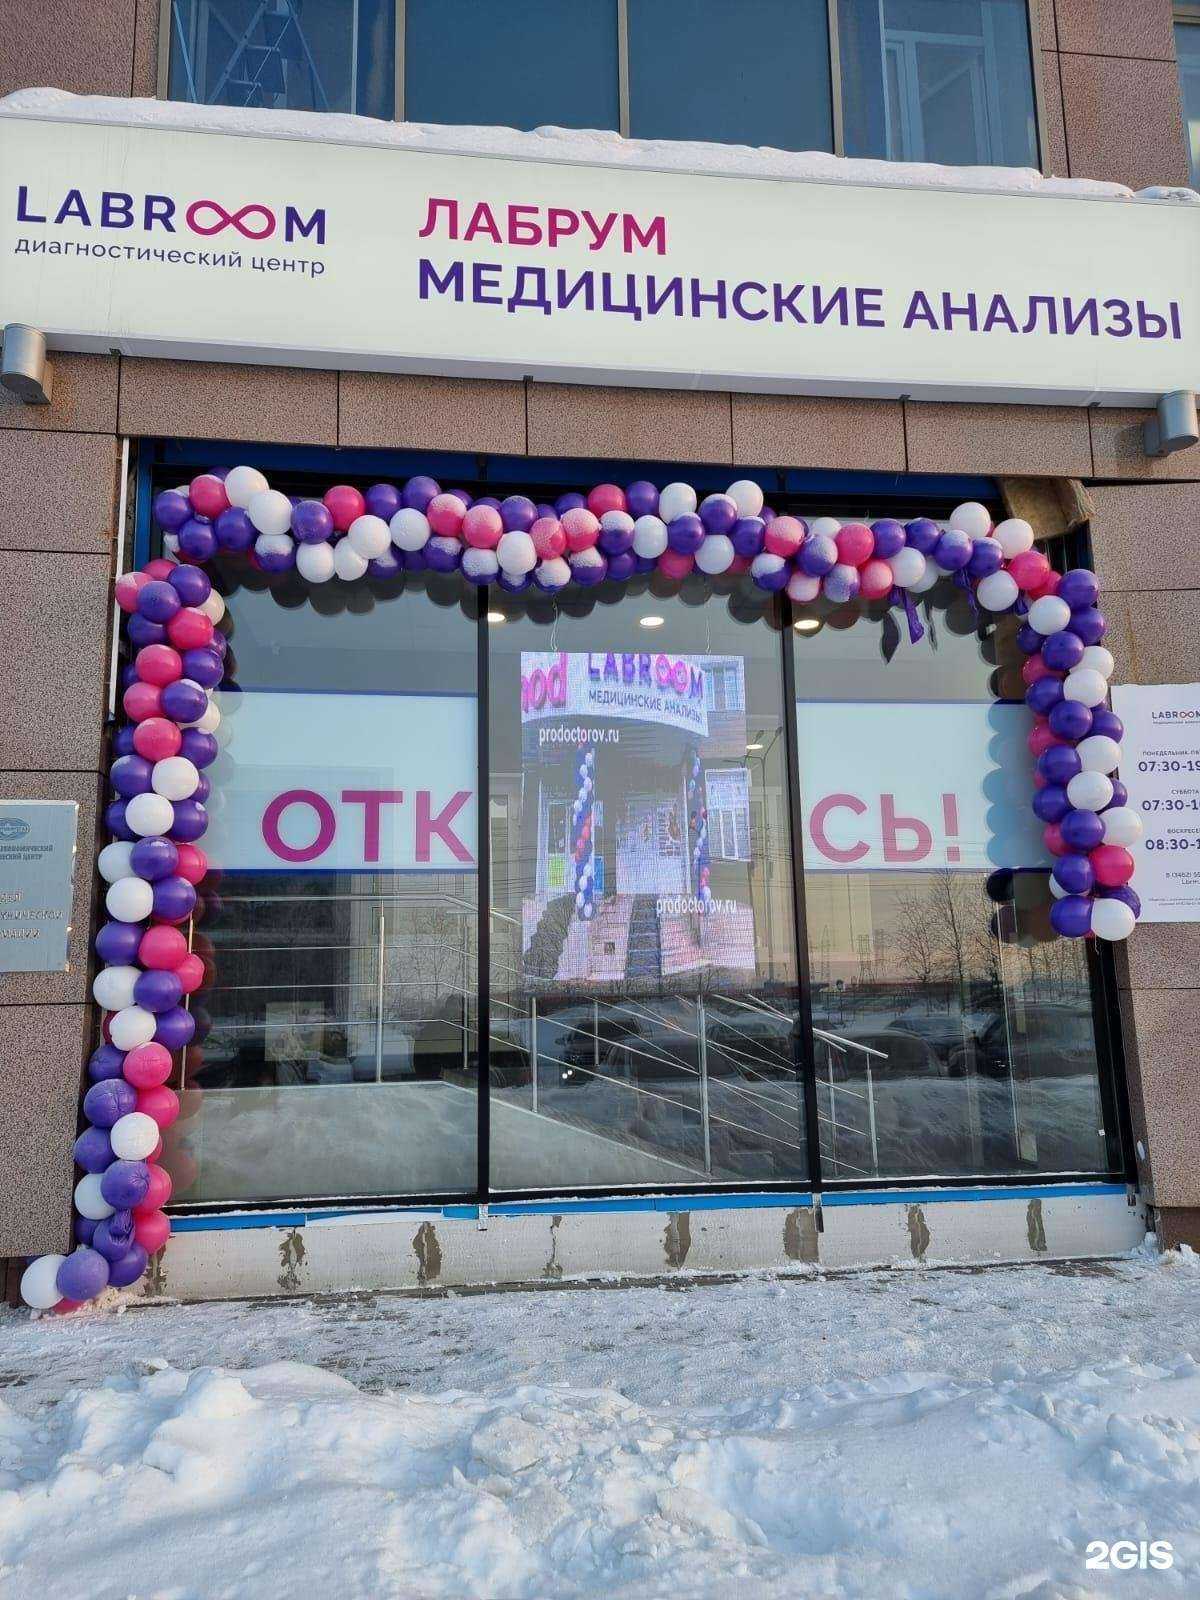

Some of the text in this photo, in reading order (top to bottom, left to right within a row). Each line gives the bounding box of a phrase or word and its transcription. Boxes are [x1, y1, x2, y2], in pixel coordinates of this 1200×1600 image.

[418, 198, 668, 256] ЛАБРУМ
[14, 238, 326, 279] диагностический центр
[418, 258, 1182, 341] МЕДИЦИНСКИЕ АНАЛИЗЫ
[588, 689, 662, 712] МЕДИЦИНСКИЕ
[538, 724, 620, 746] prodoctorov.ru
[1142, 799, 1200, 811] 07:30-1
[656, 895, 737, 917] prodoctorov.ru
